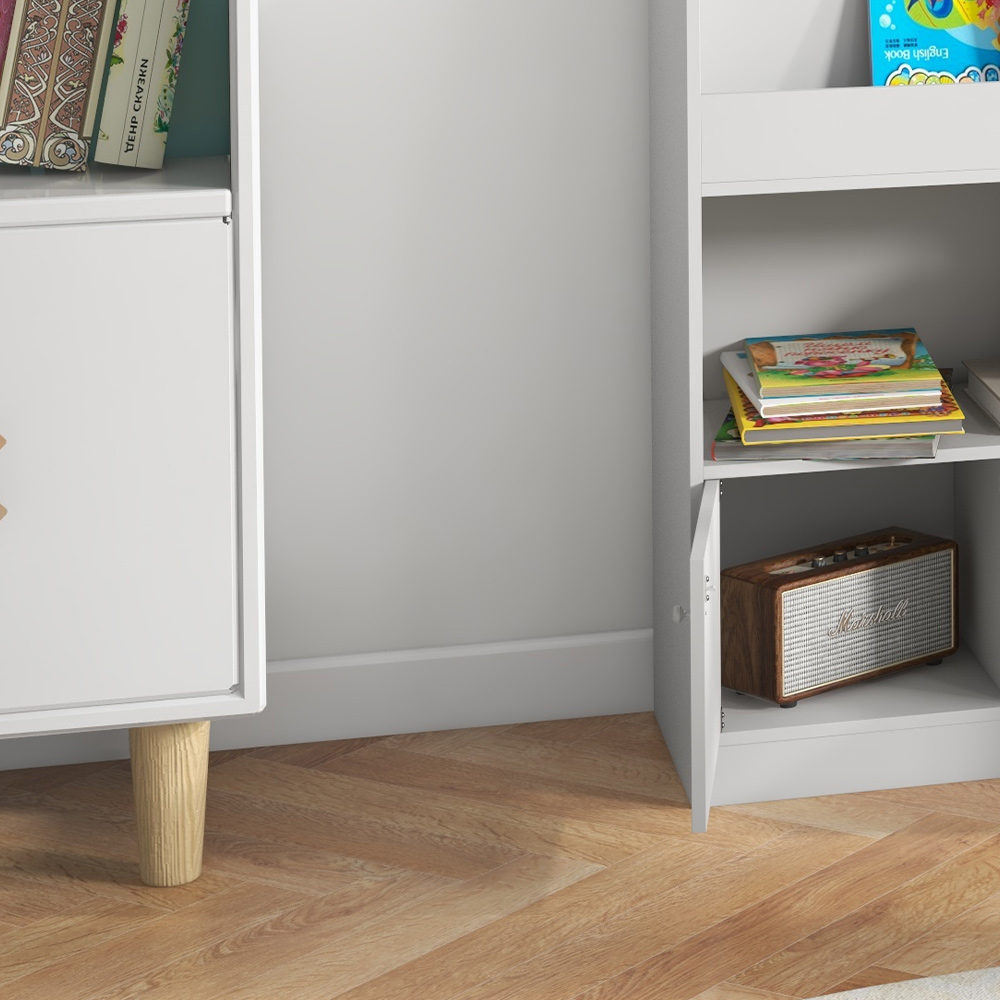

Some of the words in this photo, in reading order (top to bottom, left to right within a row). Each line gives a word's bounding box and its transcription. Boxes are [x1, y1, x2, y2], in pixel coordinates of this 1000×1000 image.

[884, 49, 910, 61] Book
[913, 47, 949, 60] English
[827, 598, 909, 637] Marshall
